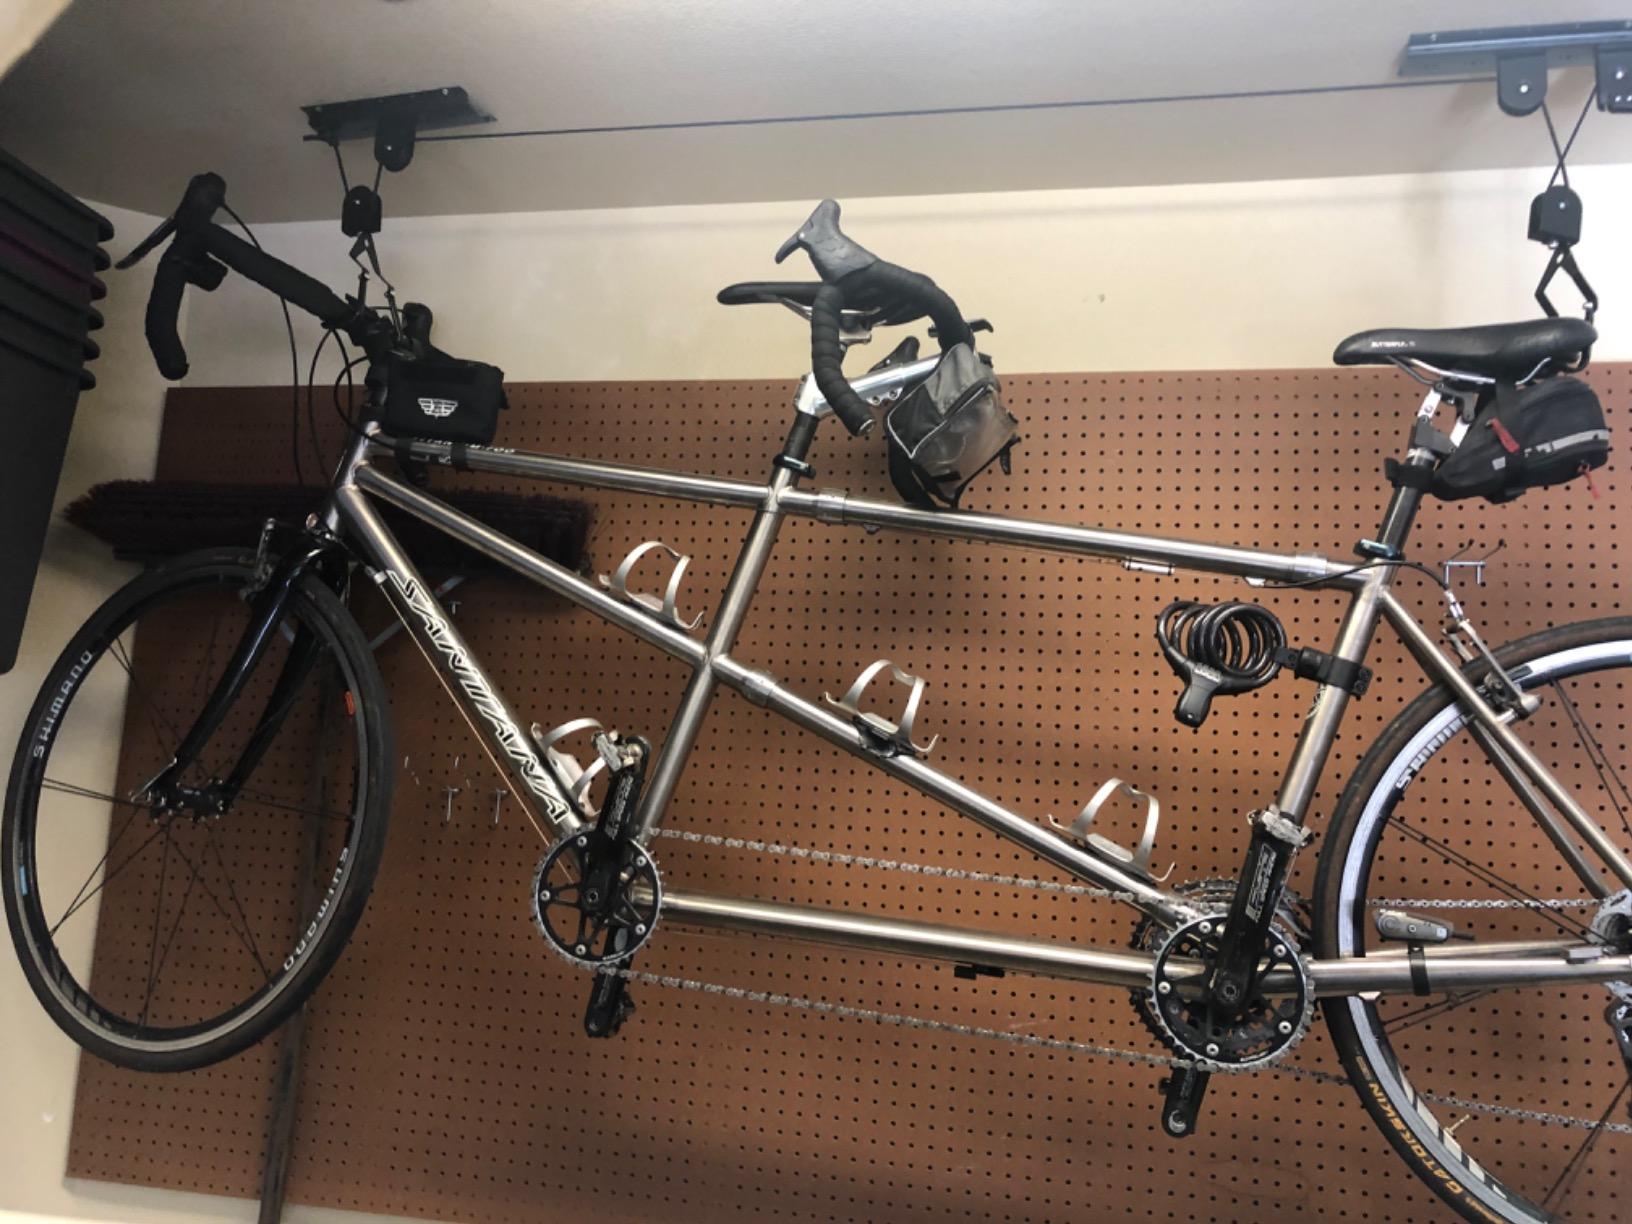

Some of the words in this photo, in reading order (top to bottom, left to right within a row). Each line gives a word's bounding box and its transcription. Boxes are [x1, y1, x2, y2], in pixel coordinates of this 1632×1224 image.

[33, 649, 93, 759] SHIMANO
[385, 569, 569, 824] SANTANA
[1368, 1083, 1463, 1193] GATORSKIN
